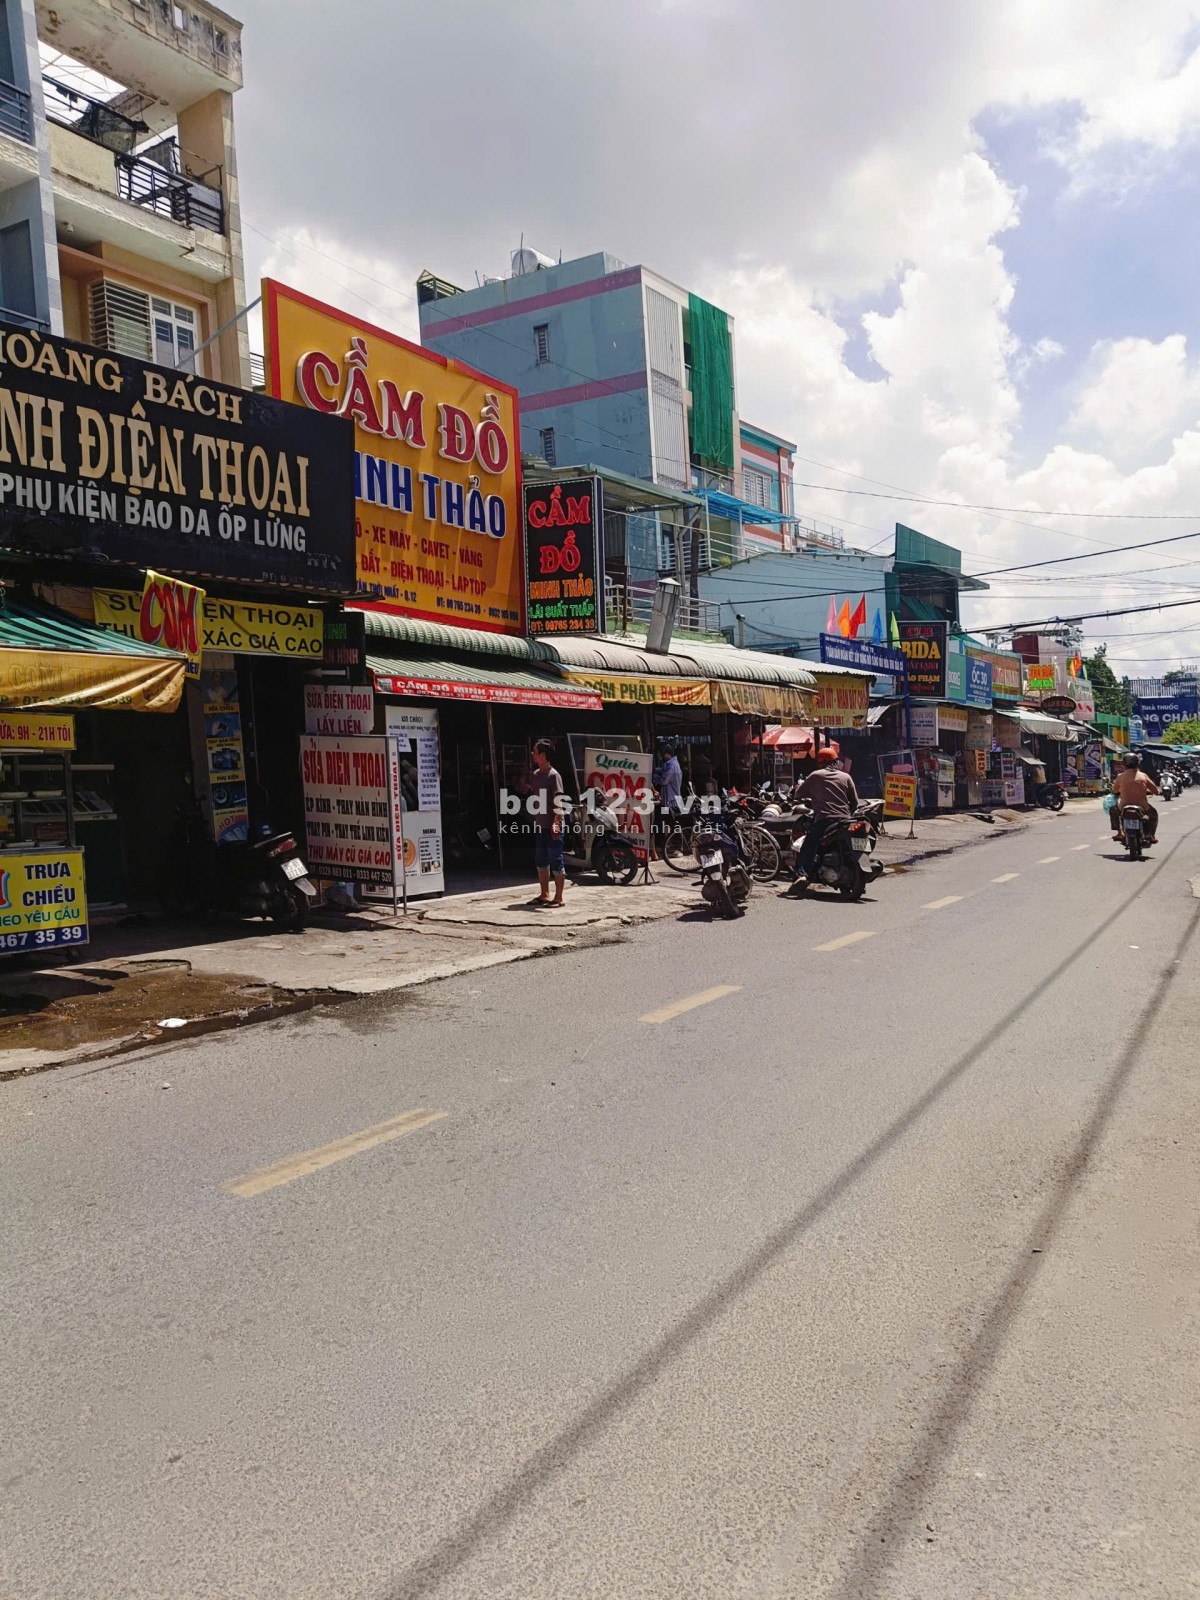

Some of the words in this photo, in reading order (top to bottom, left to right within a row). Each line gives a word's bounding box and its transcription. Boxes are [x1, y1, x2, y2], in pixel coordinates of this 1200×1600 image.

[143, 370, 242, 425] BÁCH
[296, 336, 427, 449] CẦM
[438, 393, 509, 474] ĐỒ
[77, 400, 186, 495] ĐIỆN
[192, 433, 310, 518] THOẠI
[0, 473, 51, 516] PHỤ
[125, 495, 173, 530] BAO
[180, 505, 210, 537] DA
[218, 503, 247, 541] ỐP
[418, 474, 506, 539] THẢO
[528, 485, 591, 528] CẦM
[372, 525, 386, 545] XE
[389, 528, 411, 550] MÁY
[421, 538, 450, 560] CAVET
[459, 546, 483, 568] VÀNG
[539, 530, 581, 574] ĐỒ
[361, 549, 380, 574] ĐẤT
[390, 560, 413, 583] ĐIỆN
[416, 566, 444, 591] THOẠI
[452, 574, 487, 597] LAPTOP
[562, 573, 594, 598] THẢO
[243, 607, 314, 631] THOẠI
[545, 600, 568, 618] SUẤT
[570, 598, 595, 617] THẤP
[203, 627, 242, 648] XÁC
[250, 632, 280, 650] GIÁ
[285, 637, 322, 654] CAO
[901, 641, 941, 659] BIDA
[307, 687, 322, 708] SỬA
[324, 690, 343, 713] ĐIỆN
[346, 693, 371, 714] THOẠI
[17, 725, 29, 741] 9H
[38, 725, 55, 741] 21H
[57, 718, 71, 741] TỐI
[303, 738, 324, 784] SỬA
[325, 742, 351, 793] ĐIỆN
[352, 752, 386, 797] THOẠI
[596, 754, 640, 771] Quán
[336, 799, 354, 815] THAY
[355, 796, 370, 816] MÀN
[218, 815, 236, 831] HOT
[335, 823, 348, 839] THAY
[309, 845, 323, 859] THU
[326, 843, 343, 861] MÁY
[345, 845, 355, 861] CŨ
[358, 846, 371, 864] GIÁ
[375, 850, 391, 866] CAO
[24, 861, 71, 881] TRƯA
[356, 869, 370, 880] 0333
[371, 871, 380, 881] 447
[381, 872, 392, 882] 520
[22, 883, 75, 907] CHIỀU
[24, 910, 51, 923] YÊU
[54, 904, 80, 920] CẦU
[35, 929, 56, 943] 35
[61, 926, 82, 940] 39
